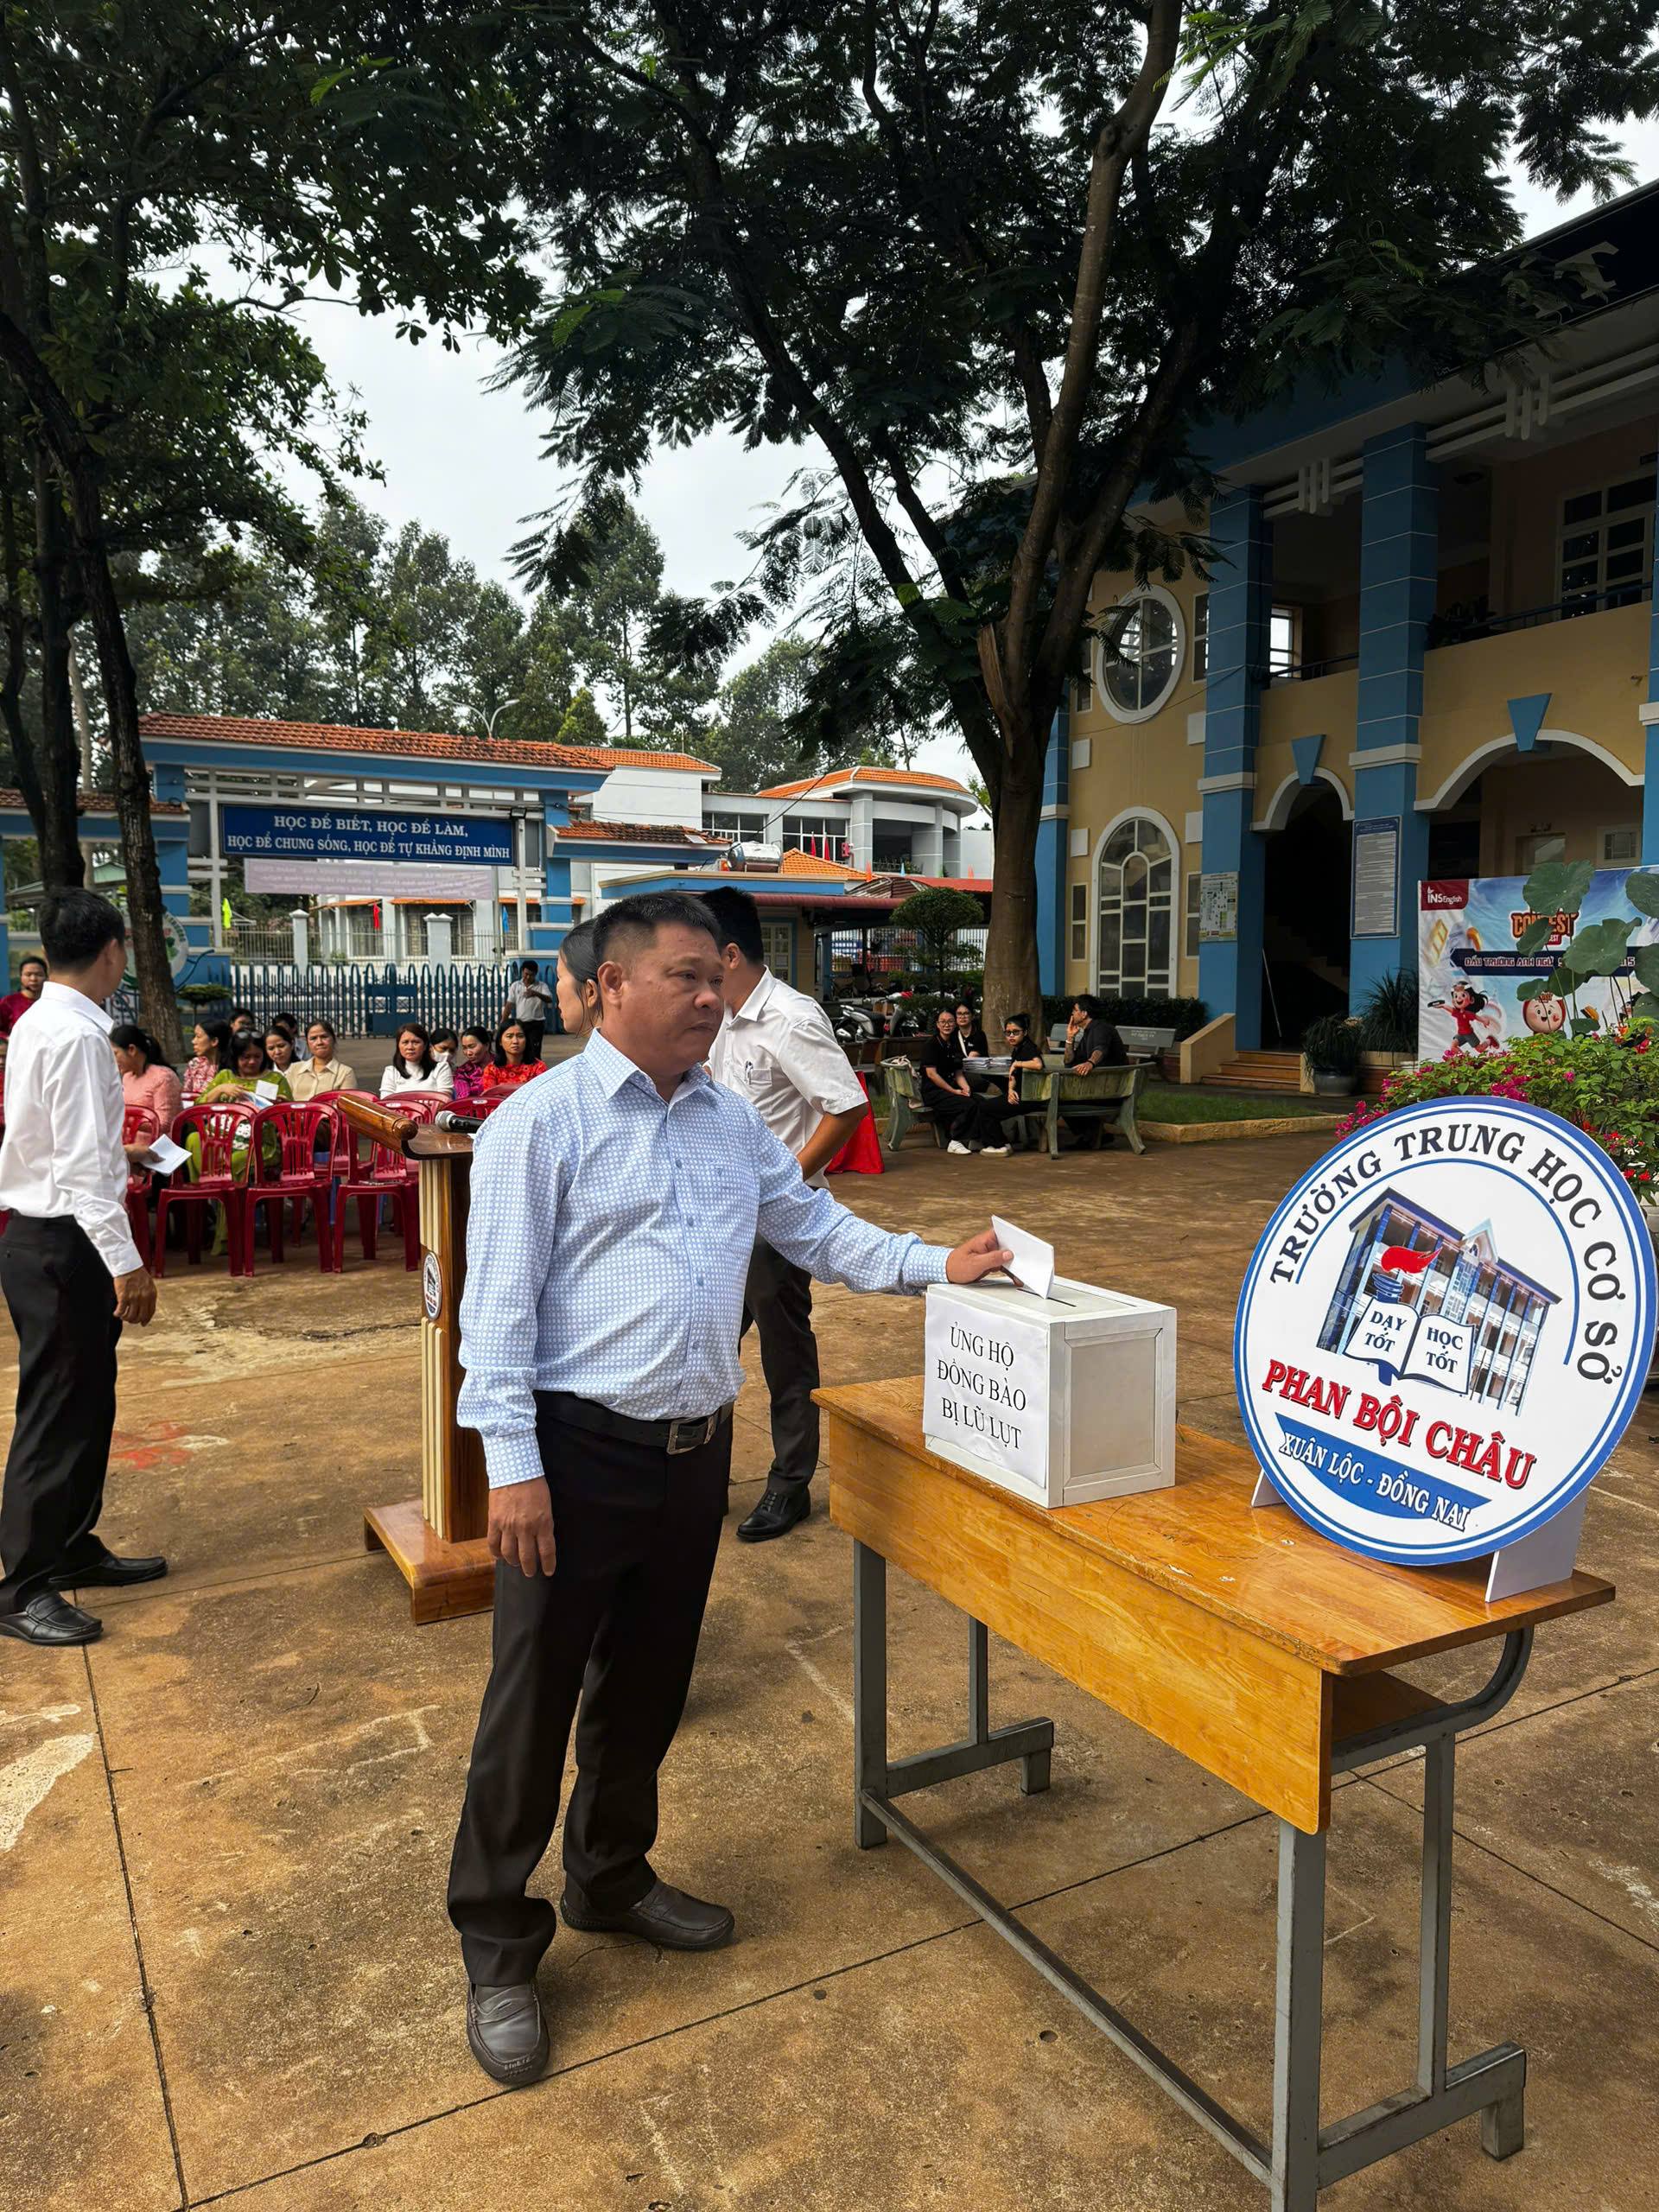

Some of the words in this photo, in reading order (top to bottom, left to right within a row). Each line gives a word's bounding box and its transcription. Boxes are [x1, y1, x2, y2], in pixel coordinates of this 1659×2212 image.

[227, 835, 253, 850] HỌC
[256, 831, 272, 849] ĐỂ
[275, 836, 315, 850] CHUNG
[317, 834, 352, 853] SỐNG,
[354, 840, 378, 855] HỌC
[380, 836, 396, 854] ĐỂ
[397, 842, 413, 857] TỰ
[454, 846, 481, 860] ĐỊNH
[483, 844, 510, 859] MÌNH
[274, 815, 307, 830] HỌC
[310, 812, 332, 830] ĐỂ
[336, 814, 372, 832] BIẾT,
[377, 820, 408, 836] HỌC
[410, 818, 431, 835] ĐỂ
[435, 822, 468, 837] LÀM,
[1394, 1123, 1526, 1164] TRUNG
[1528, 1147, 1602, 1231] HỌC
[1270, 1149, 1382, 1285] TRƯỜNG
[1583, 1240, 1627, 1301] CƠ
[950, 1321, 983, 1357] ỦNG
[988, 1339, 1014, 1371] HỘ
[1363, 1332, 1396, 1353] TỐT
[1370, 1310, 1408, 1332] DẠY
[1426, 1326, 1464, 1351] HỌC
[1426, 1351, 1459, 1373] TỐT
[1578, 1319, 1624, 1385] SỞ
[937, 1357, 985, 1395] ĐỒNG
[988, 1376, 1027, 1411] BÀO
[942, 1396, 960, 1427] BỊ
[962, 1404, 985, 1432] LŨ
[988, 1415, 1022, 1450] LỤT
[1262, 1358, 1353, 1420] PHAN
[1353, 1384, 1419, 1446] BỘI
[1425, 1420, 1537, 1490] CHÂU
[1279, 1431, 1326, 1470] XUÂN
[1326, 1451, 1365, 1486] LỘC
[1376, 1468, 1430, 1517] ĐỒNG
[1432, 1498, 1472, 1532] NAI
